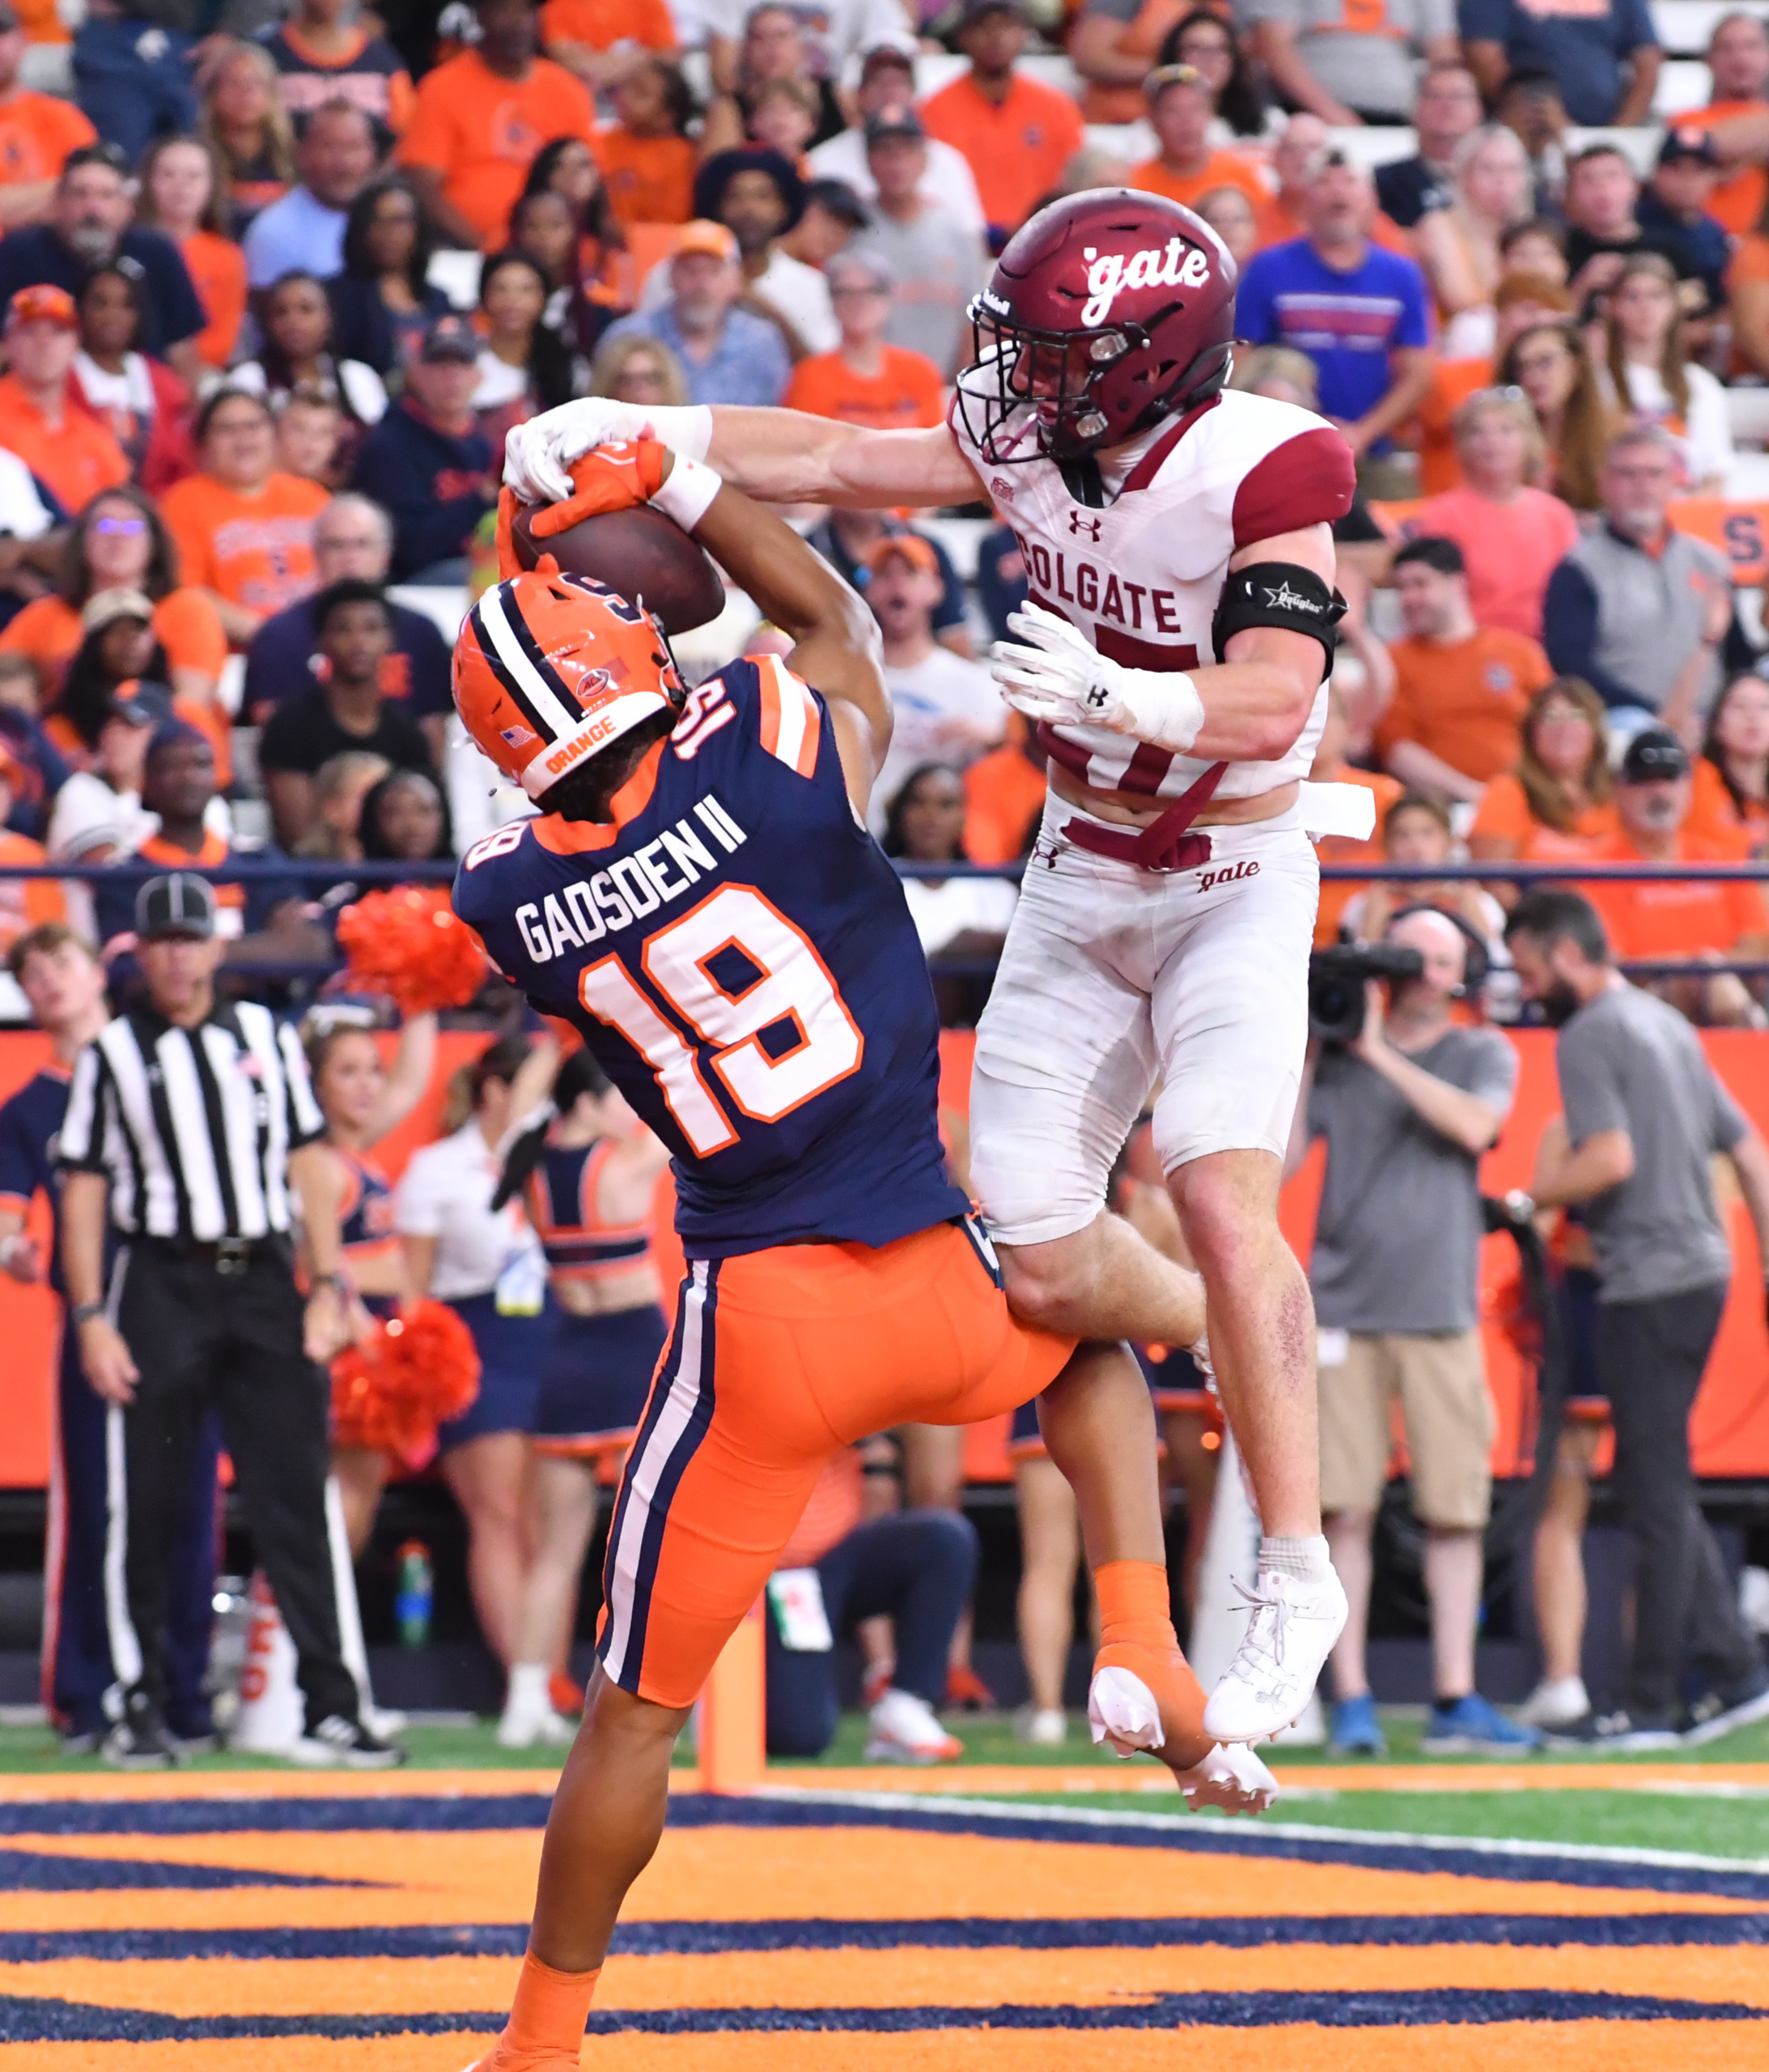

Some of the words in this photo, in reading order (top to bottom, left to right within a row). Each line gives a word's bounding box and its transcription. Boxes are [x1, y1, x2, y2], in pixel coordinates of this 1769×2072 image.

[1014, 530, 1181, 634] COLGATE
[545, 715, 617, 775] ORANGE
[515, 818, 719, 963] GADSDEN
[693, 794, 748, 853] II
[578, 881, 865, 1159] 19
